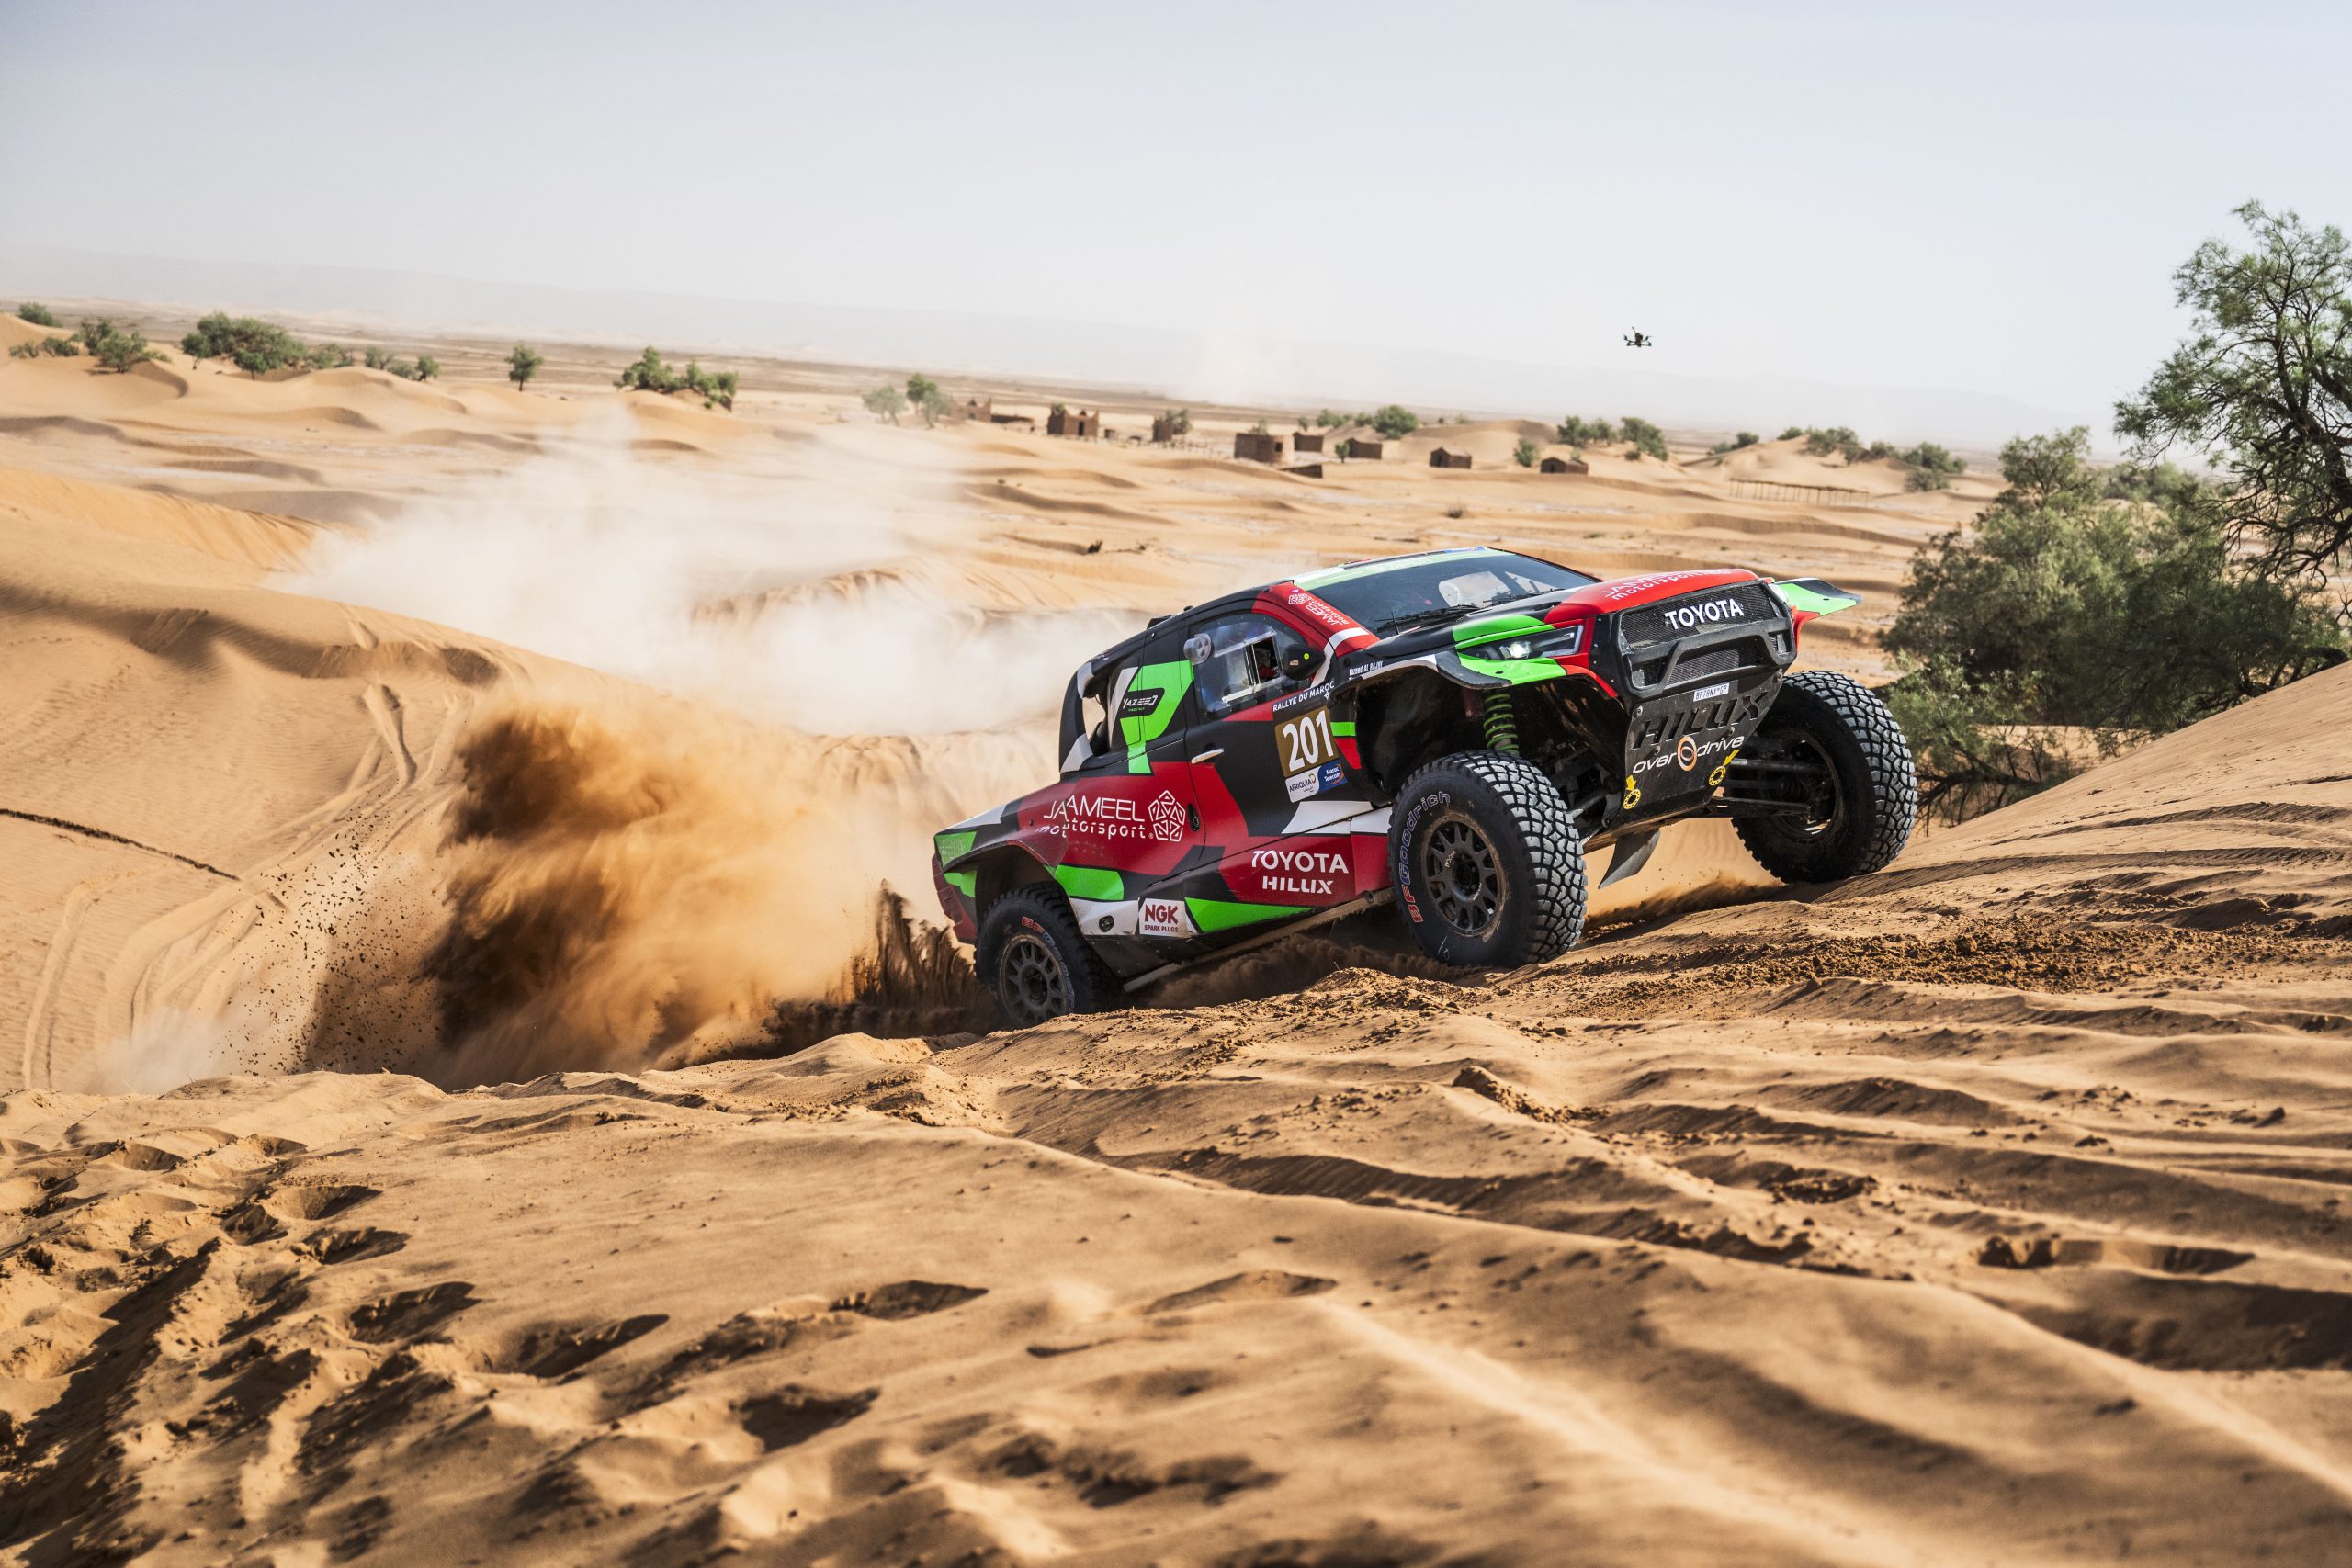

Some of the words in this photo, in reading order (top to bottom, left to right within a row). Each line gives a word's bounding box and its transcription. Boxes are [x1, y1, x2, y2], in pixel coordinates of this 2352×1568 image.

[1664, 598, 1745, 630] TOYOTA
[1272, 696, 1297, 712] RALLYE
[1298, 691, 1308, 703] DU
[1309, 681, 1335, 698] MAROC
[1283, 710, 1334, 772] 201
[1324, 773, 1341, 783] Telecom
[1326, 767, 1340, 775] Maroc
[1289, 778, 1312, 793] AFRIQUIA
[1251, 850, 1349, 874] TOYOTA
[1262, 875, 1334, 895] HILUX
[1144, 904, 1179, 925] NGK
[1160, 925, 1179, 933] PLUGS
